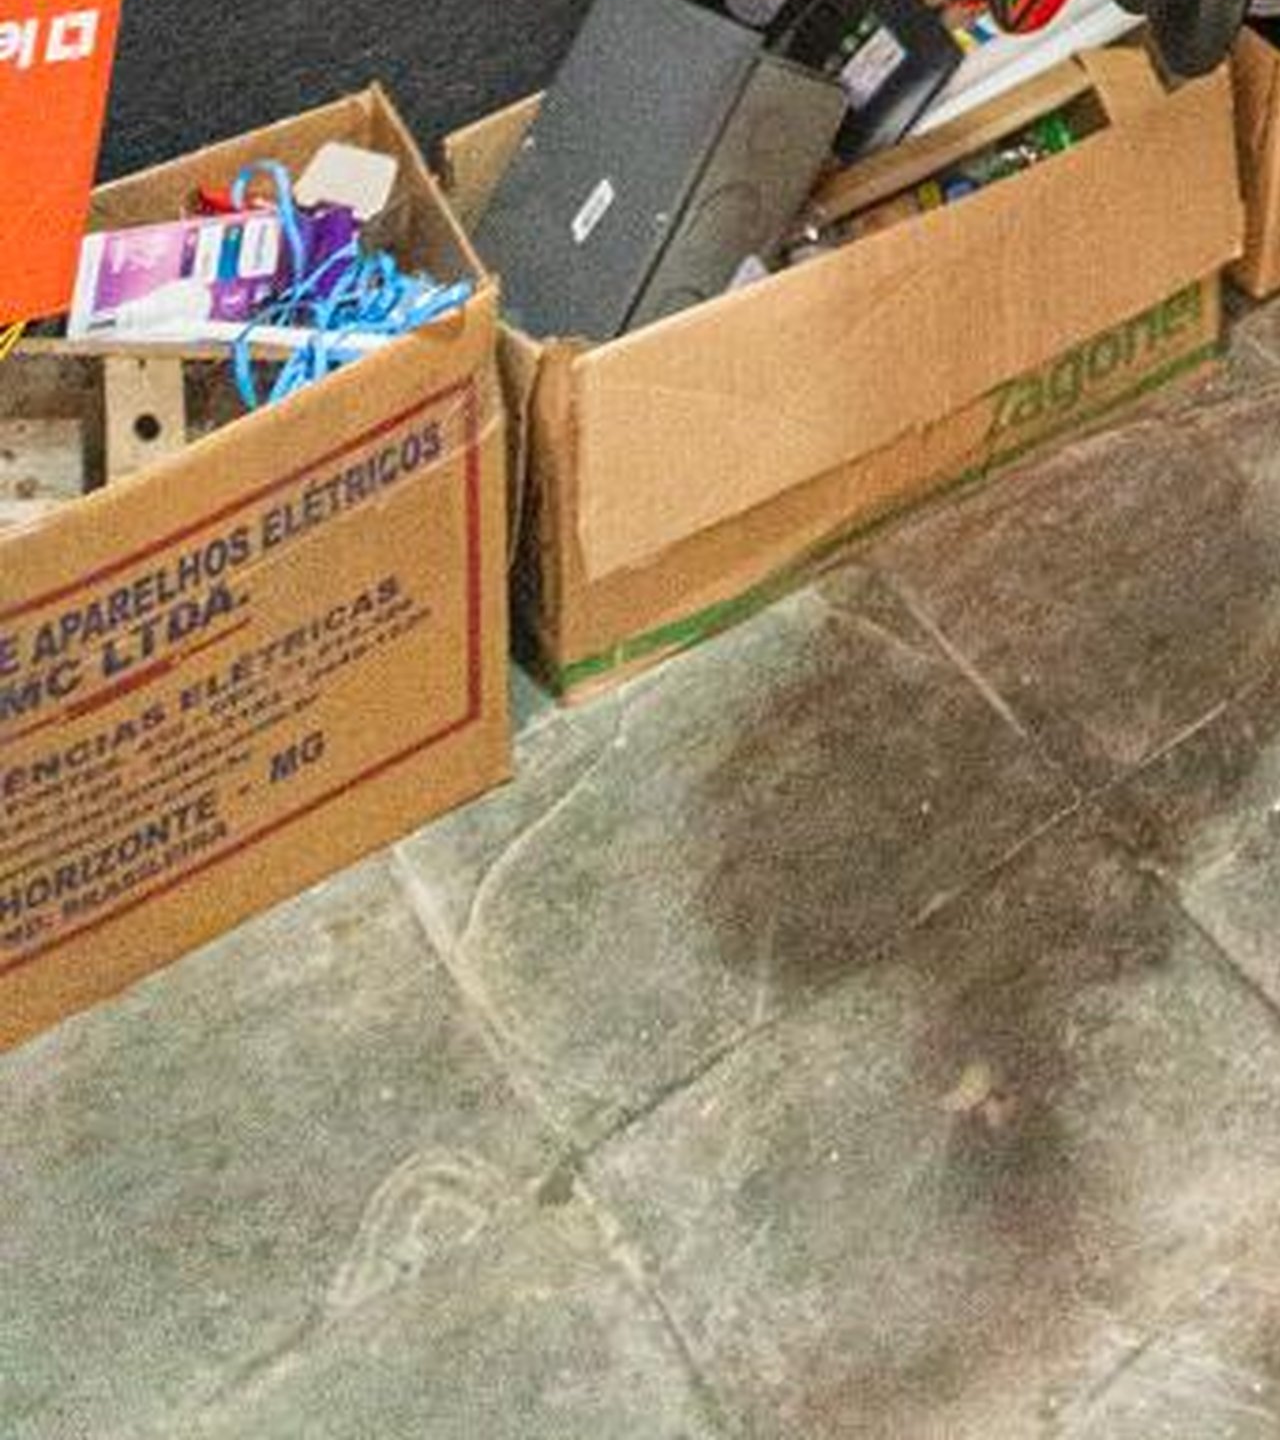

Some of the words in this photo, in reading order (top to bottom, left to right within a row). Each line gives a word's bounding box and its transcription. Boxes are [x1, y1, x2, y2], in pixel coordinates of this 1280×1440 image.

[31, 527, 250, 665] APARELHOS
[261, 420, 445, 548] ELÉTRICOS
[101, 582, 252, 678] LTDA.
[0, 788, 216, 919] HORIZONTE
[268, 730, 326, 783] MG
